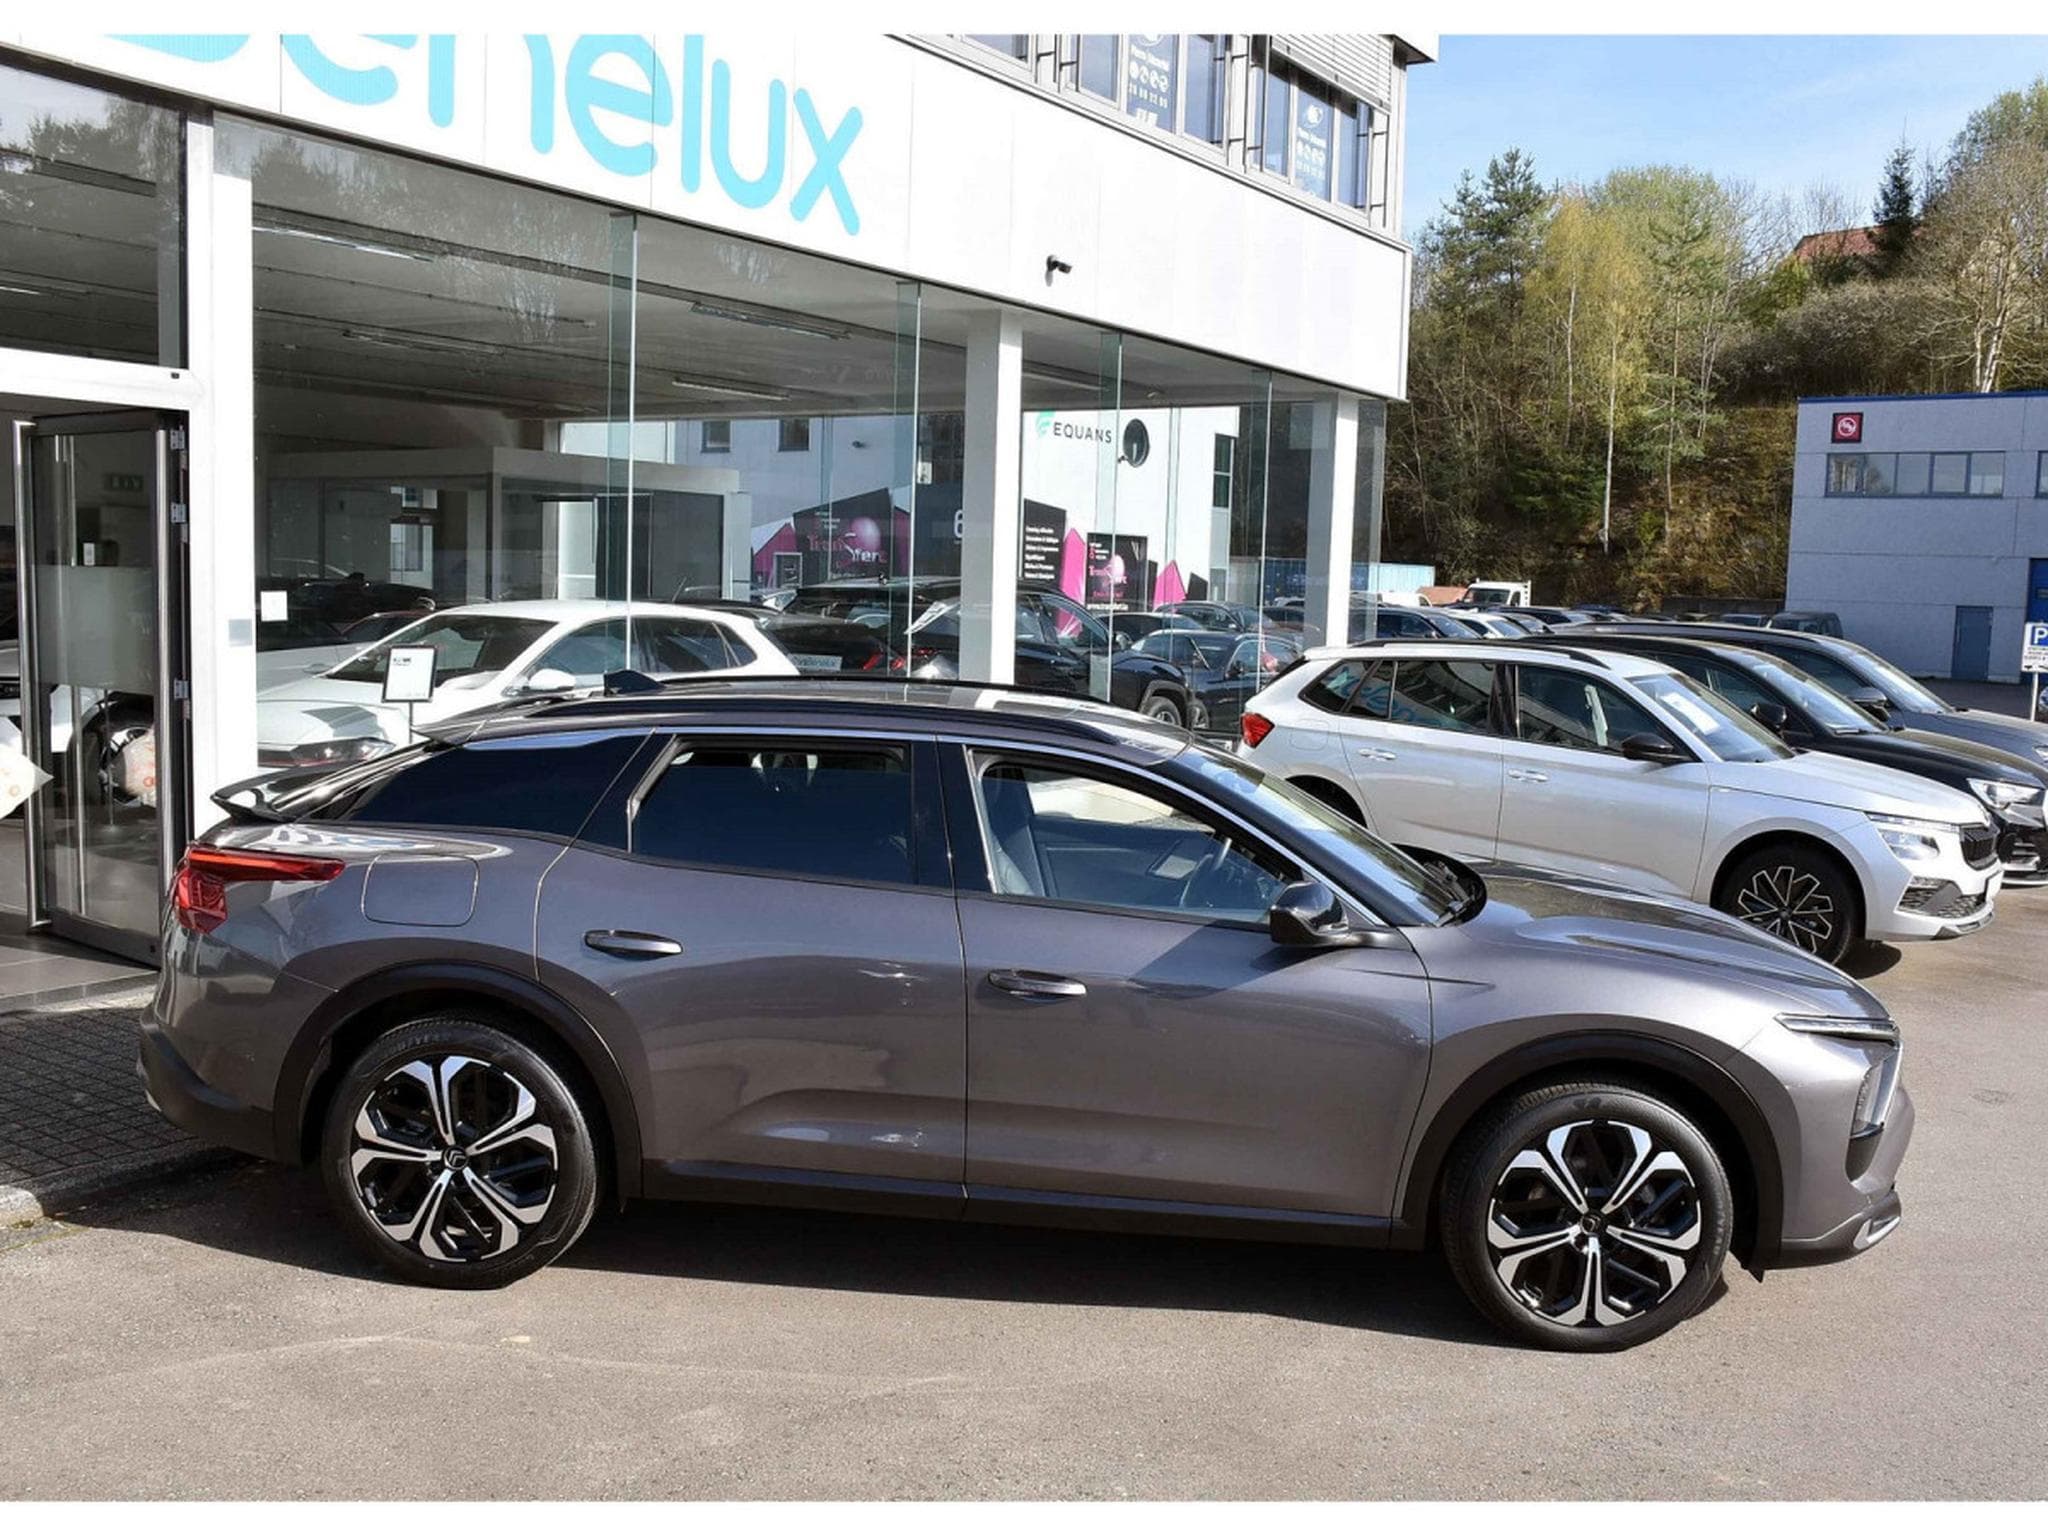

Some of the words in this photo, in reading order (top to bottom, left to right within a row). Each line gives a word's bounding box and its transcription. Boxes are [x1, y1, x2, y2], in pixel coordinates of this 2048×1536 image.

[98, 34, 863, 236] nelux
[1053, 421, 1112, 443] EQUANS
[2033, 627, 2048, 644] P
